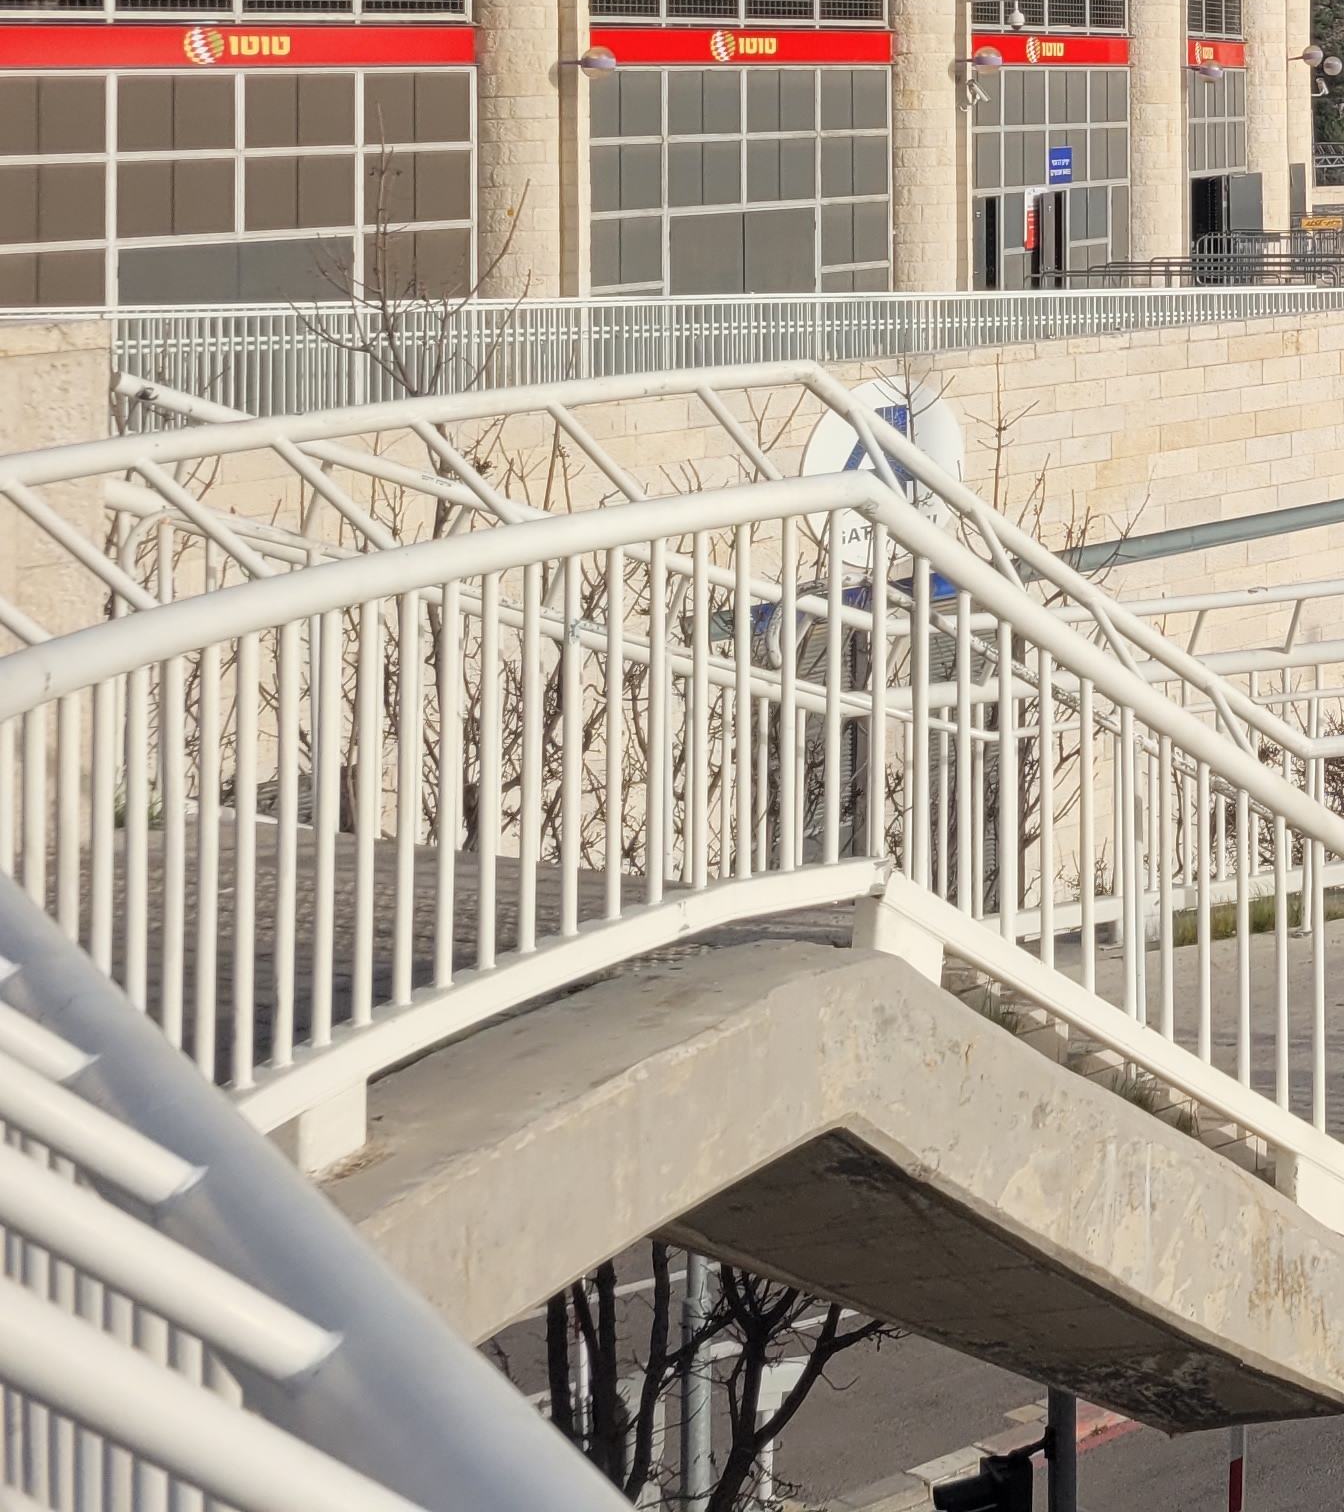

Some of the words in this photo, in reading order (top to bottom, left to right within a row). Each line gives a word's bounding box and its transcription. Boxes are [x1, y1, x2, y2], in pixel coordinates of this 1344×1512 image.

[229, 35, 291, 56] טוטו
[738, 37, 777, 55] טוטו
[1041, 41, 1065, 57] טוטו
